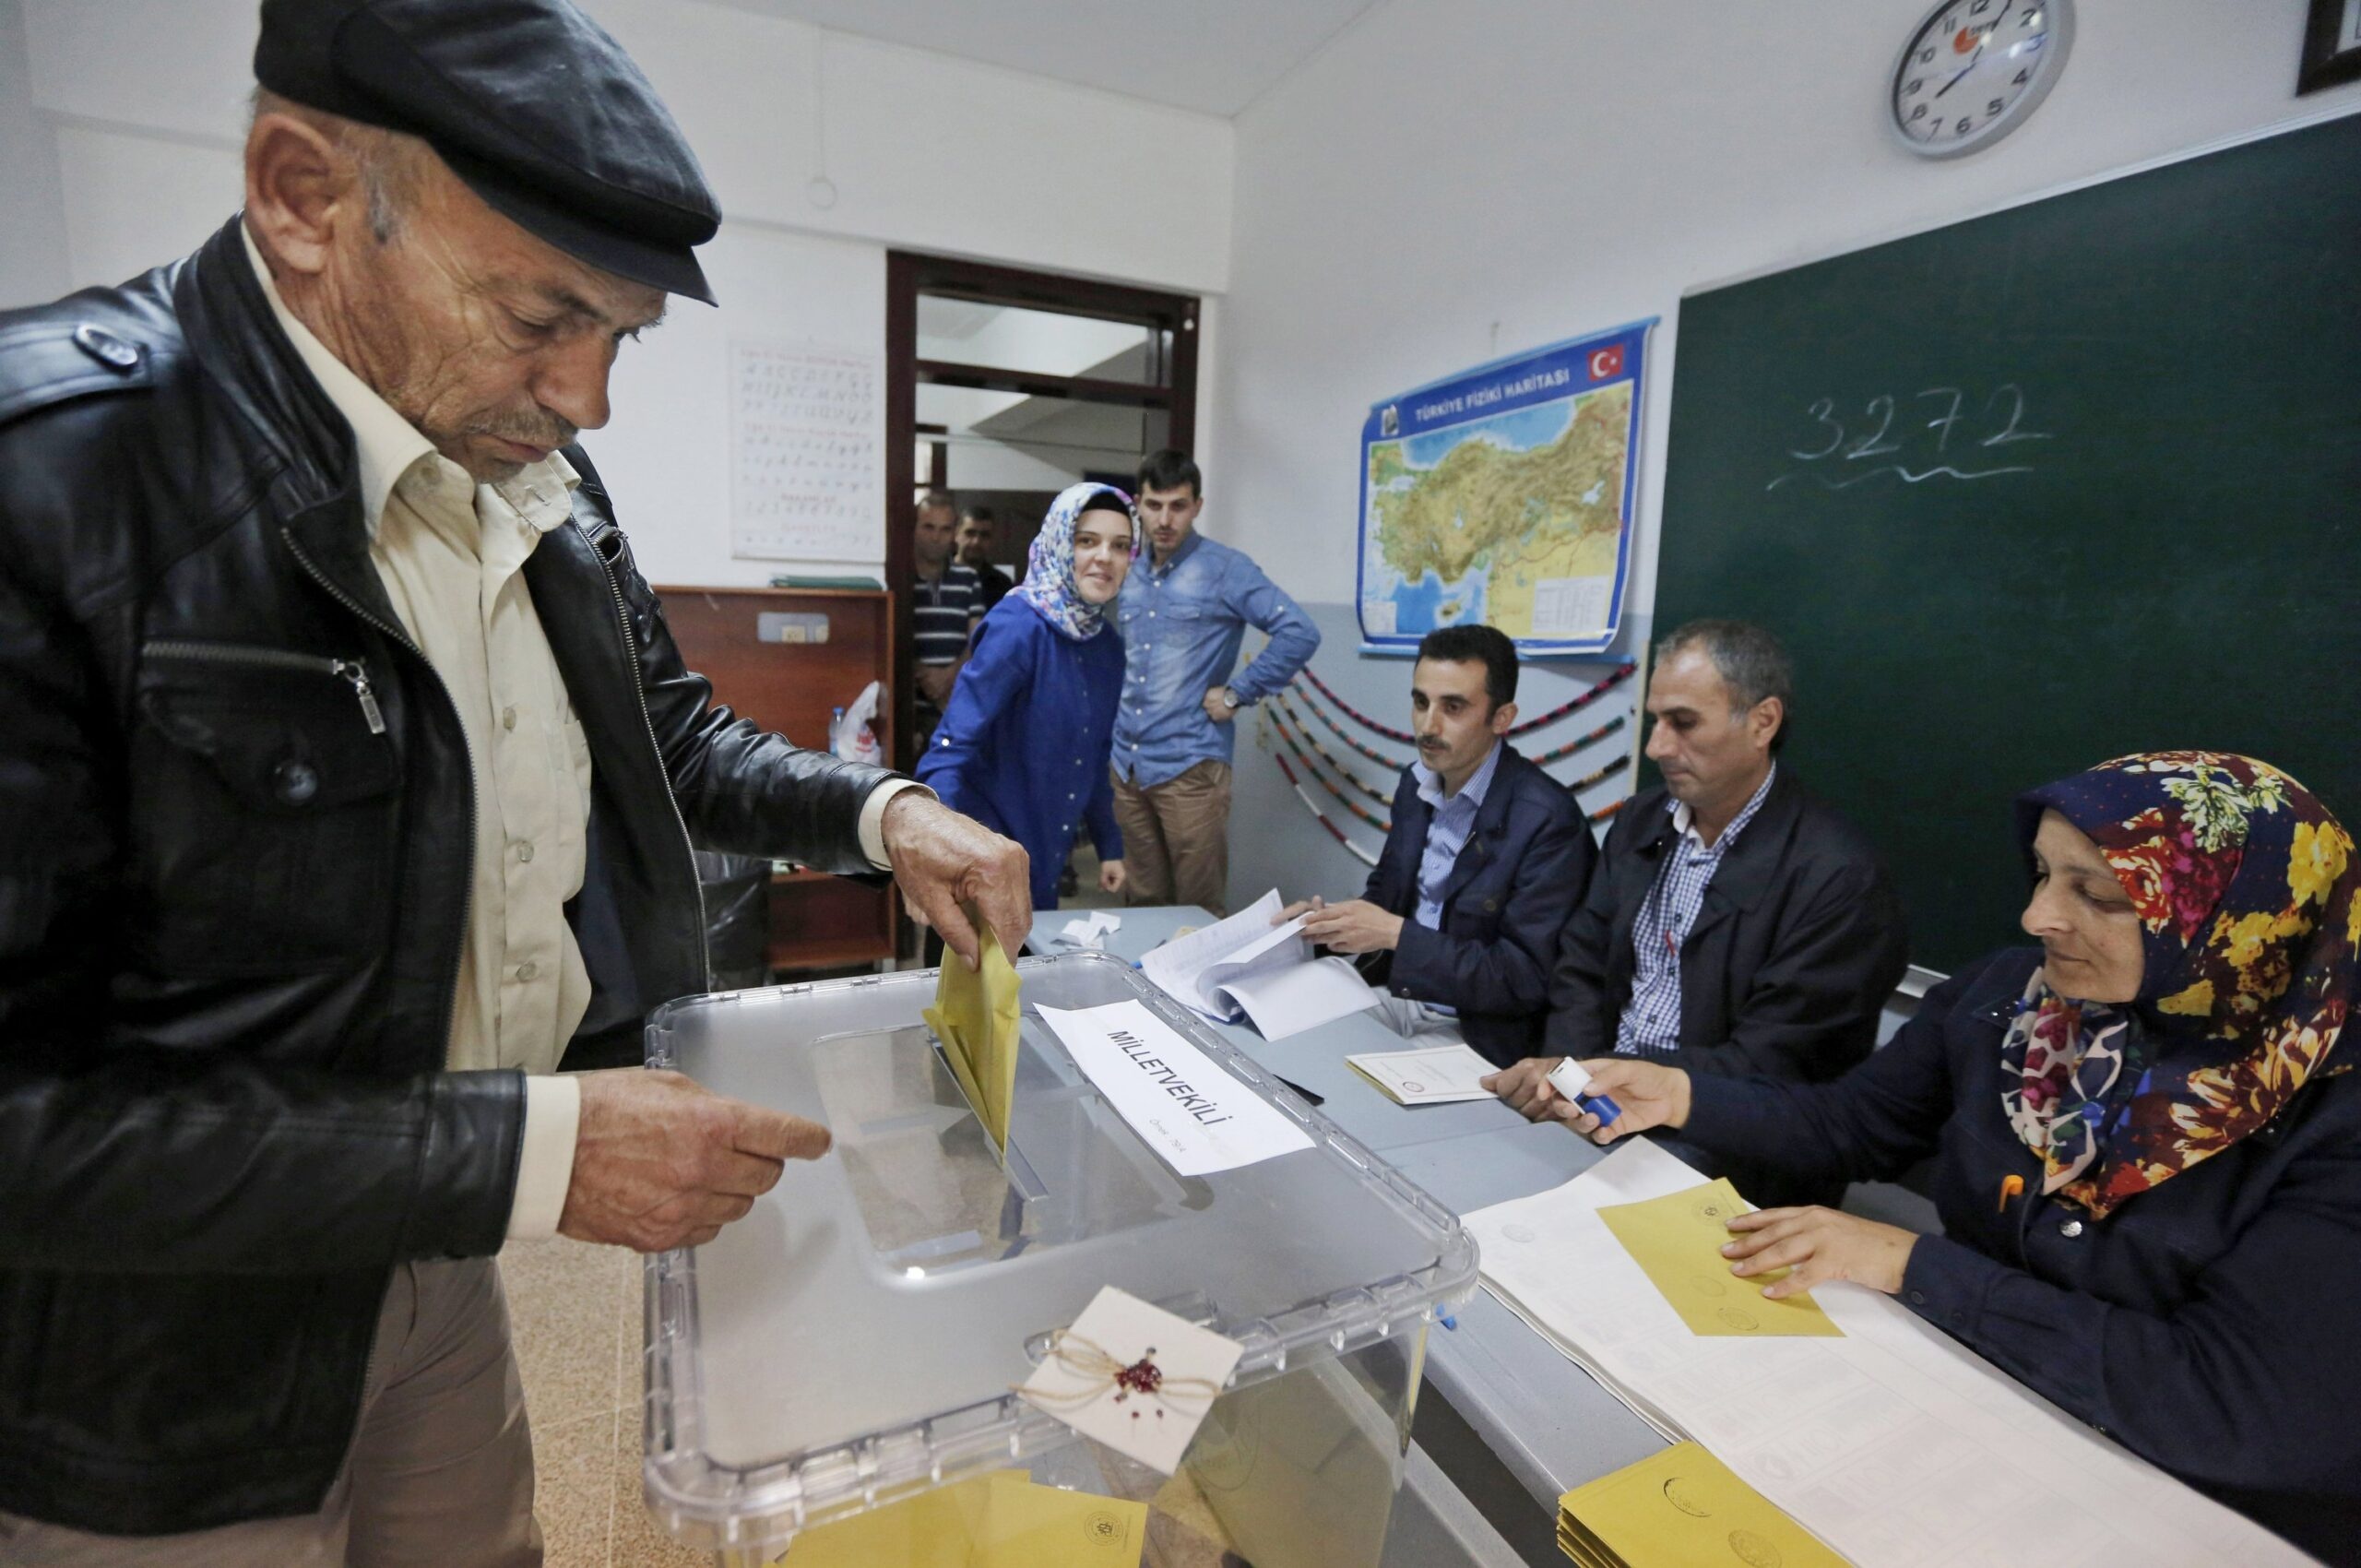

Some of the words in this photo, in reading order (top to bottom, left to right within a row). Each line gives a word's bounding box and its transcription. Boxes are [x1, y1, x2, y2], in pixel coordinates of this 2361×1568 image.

[2011, 67, 2028, 86] 4
[1956, 116, 1972, 134] 6
[1987, 98, 2004, 116] 5
[1416, 397, 1464, 422] TÜRKİYE
[1504, 368, 1570, 398] HARİTASI
[1790, 384, 2054, 459] 3272
[1107, 1030, 1233, 1125] MİLLETVEKİLİ
